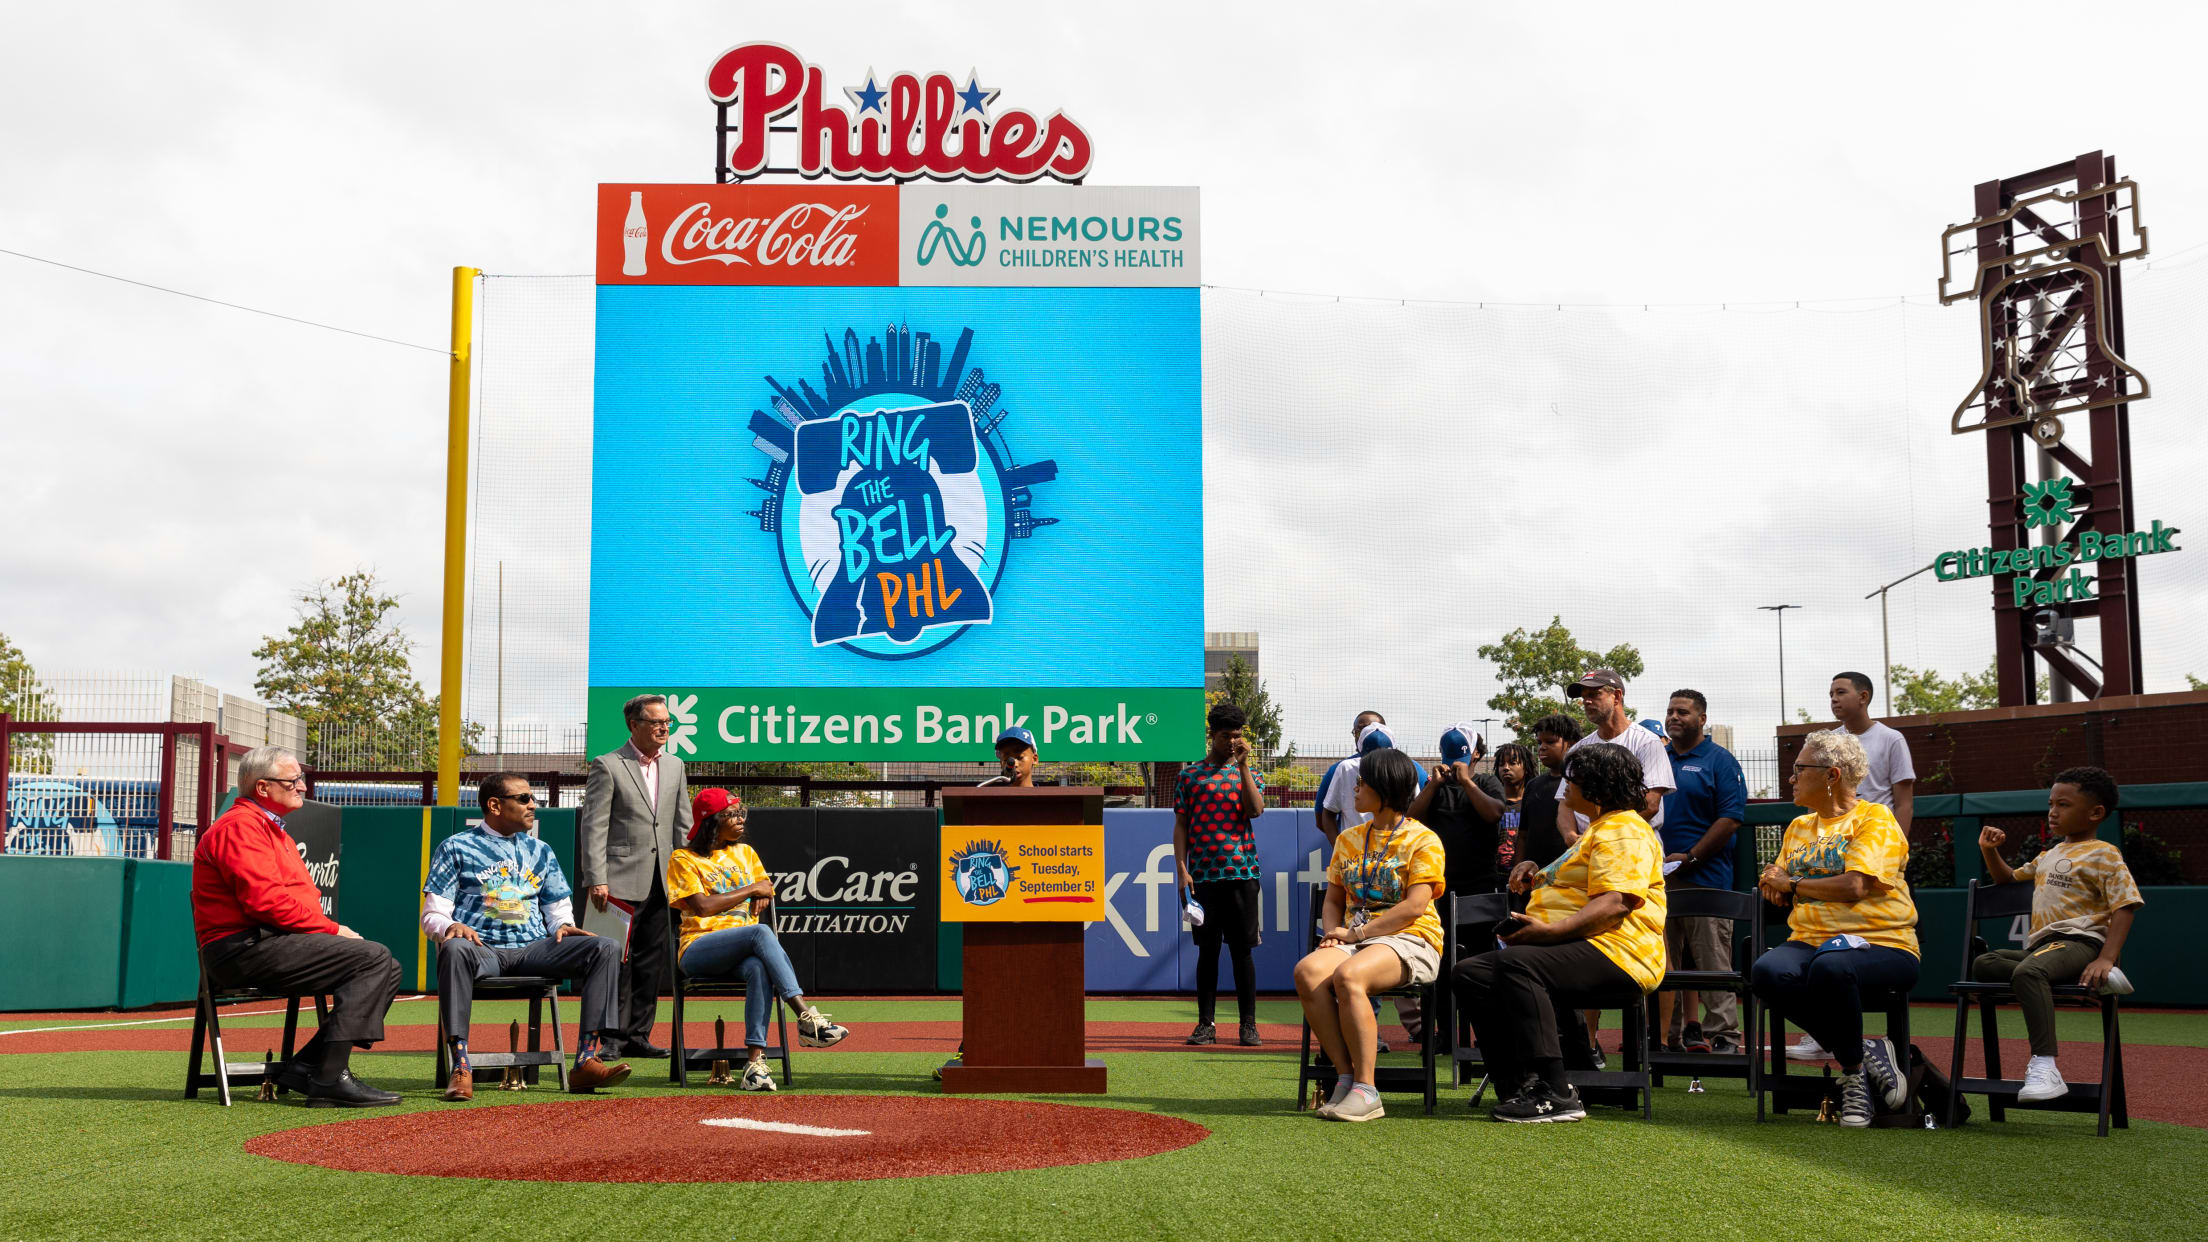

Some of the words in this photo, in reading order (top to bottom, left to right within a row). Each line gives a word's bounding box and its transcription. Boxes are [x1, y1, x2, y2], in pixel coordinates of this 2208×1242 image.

[706, 41, 1094, 183] Phillies
[662, 202, 871, 266] Coca-Cola
[1000, 216, 1182, 242] NEMOURS
[1000, 249, 1109, 268] CHILDREN'S
[1114, 249, 1183, 268] HEALTH
[840, 413, 930, 471] RING
[855, 476, 894, 507] THE
[834, 493, 954, 583] BELL
[1934, 541, 2074, 582] Citizens
[2079, 520, 2176, 563] Bank
[877, 558, 962, 629] PHL
[2013, 567, 2095, 607] Park
[717, 704, 902, 744] Citizens
[916, 703, 1030, 744] Bank
[12, 796, 70, 829] RING
[970, 856, 991, 868] RING
[1018, 845, 1057, 857] School
[1060, 846, 1093, 857] starts
[969, 873, 997, 891] BELL
[1031, 863, 1080, 876] Tuesday,
[979, 885, 998, 899] PHL
[1019, 880, 1081, 894] September
[1084, 880, 1095, 892] 5!
